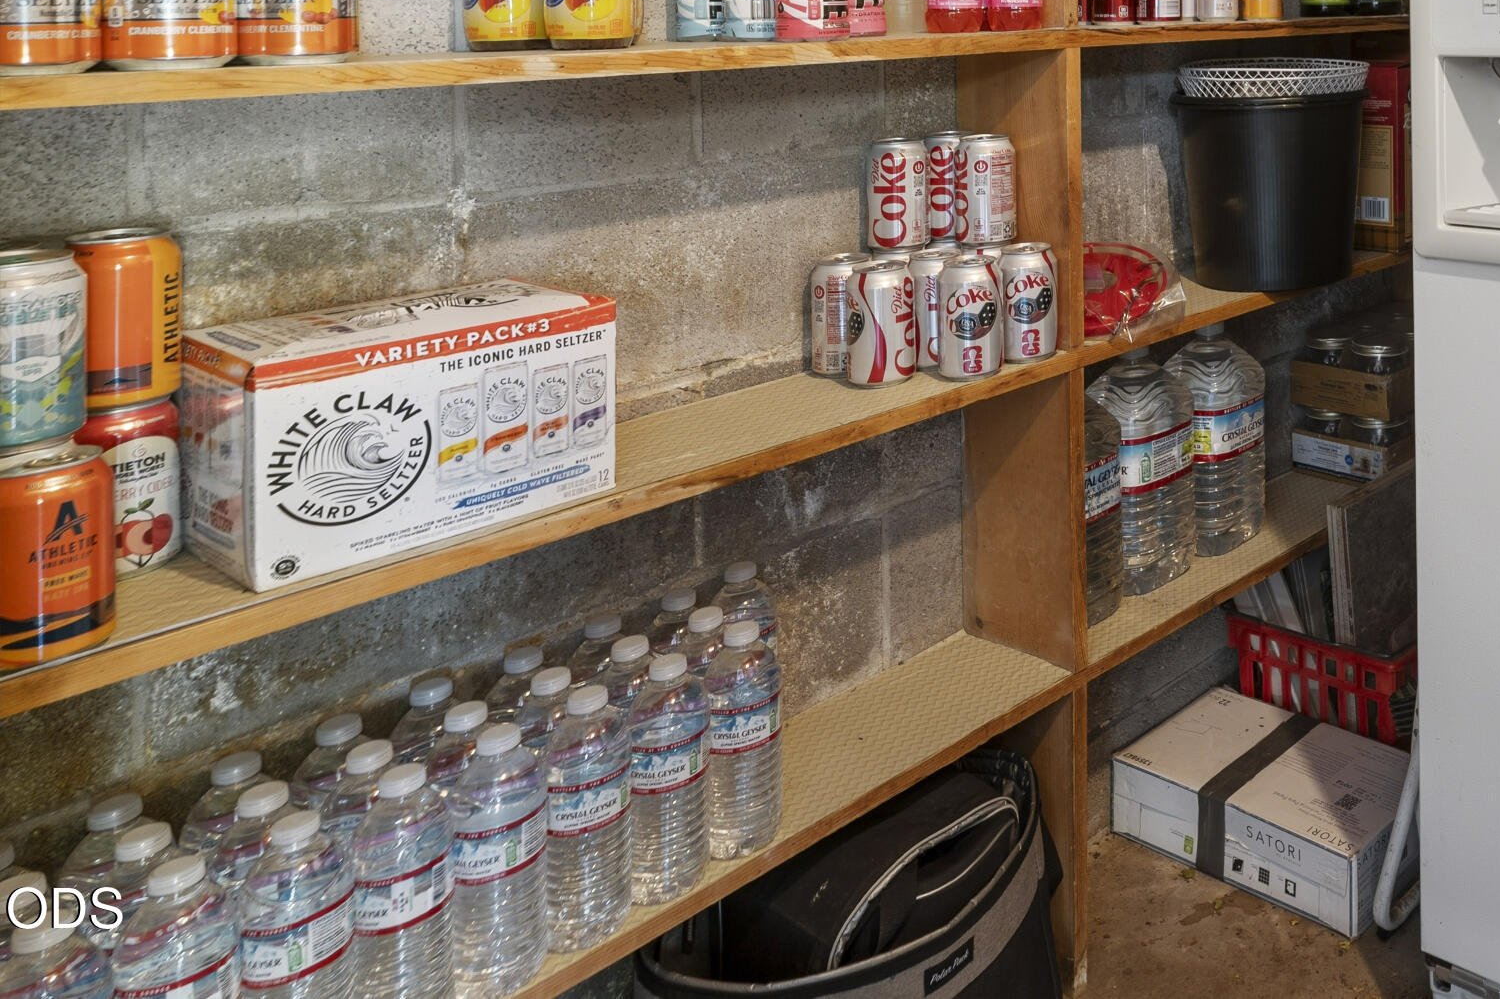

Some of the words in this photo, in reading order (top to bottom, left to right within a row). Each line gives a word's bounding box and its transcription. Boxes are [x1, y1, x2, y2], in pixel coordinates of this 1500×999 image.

[872, 158, 880, 185] Diet
[873, 151, 907, 248] Coke
[930, 145, 955, 238] Coke
[891, 286, 903, 314] Diet
[1005, 273, 1050, 300] Coke
[946, 288, 993, 315] Coke
[163, 271, 181, 363] ATHLETIC
[354, 335, 460, 367] VARIETY
[440, 358, 464, 373] THE
[468, 348, 515, 368] ICONIC
[519, 340, 551, 358] HARD
[266, 408, 328, 497] WHITE
[333, 391, 423, 423] CLAW
[1222, 426, 1247, 443] CRYSTAL
[110, 453, 166, 473] TIETON
[598, 468, 610, 482] 12
[297, 500, 356, 519] HARD
[367, 436, 424, 509] SELTZER
[465, 490, 506, 506] UNIQUELY
[507, 483, 528, 495] COLD
[529, 478, 551, 489] WAVE
[551, 467, 585, 482] FILTERED
[28, 534, 98, 564] ATHLETIC
[713, 732, 740, 740] CRYSTAL
[741, 723, 767, 737] GEYSER
[657, 764, 686, 778] GEYSER
[555, 811, 587, 821] CRYSTAL
[589, 797, 618, 815] GEYSER
[1246, 825, 1302, 862] SATORI
[1306, 826, 1355, 851] SATORI
